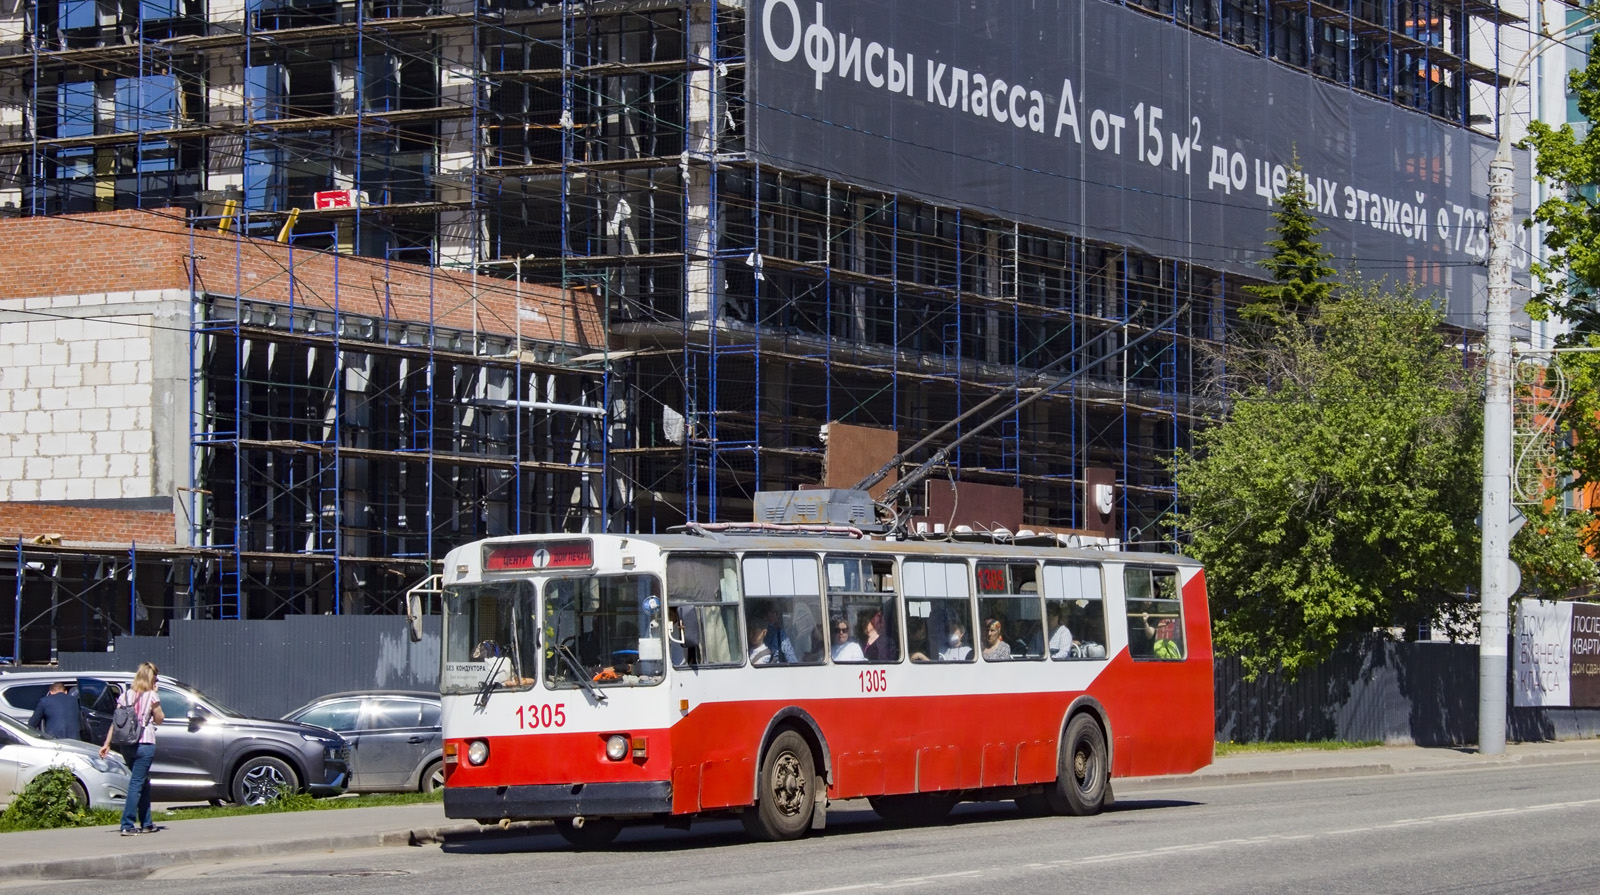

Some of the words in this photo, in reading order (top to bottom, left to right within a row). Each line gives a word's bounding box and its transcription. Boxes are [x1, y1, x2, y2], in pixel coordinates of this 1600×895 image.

[761, 0, 914, 97] Офисы
[927, 59, 1045, 134] класса
[1054, 78, 1082, 144] А
[1090, 109, 1126, 155] от
[1133, 102, 1164, 167] 15
[1208, 145, 1247, 195] до
[1344, 185, 1428, 243] этажей
[503, 555, 528, 566] ЦЕНТР
[536, 549, 545, 568] 1
[977, 568, 1005, 591] 1305
[1520, 615, 1546, 639] ДОМ
[456, 664, 486, 672] КОНДУКТОРА
[858, 669, 887, 693] 1305
[1520, 671, 1561, 692] КЛАССА
[515, 703, 567, 730] 1305
